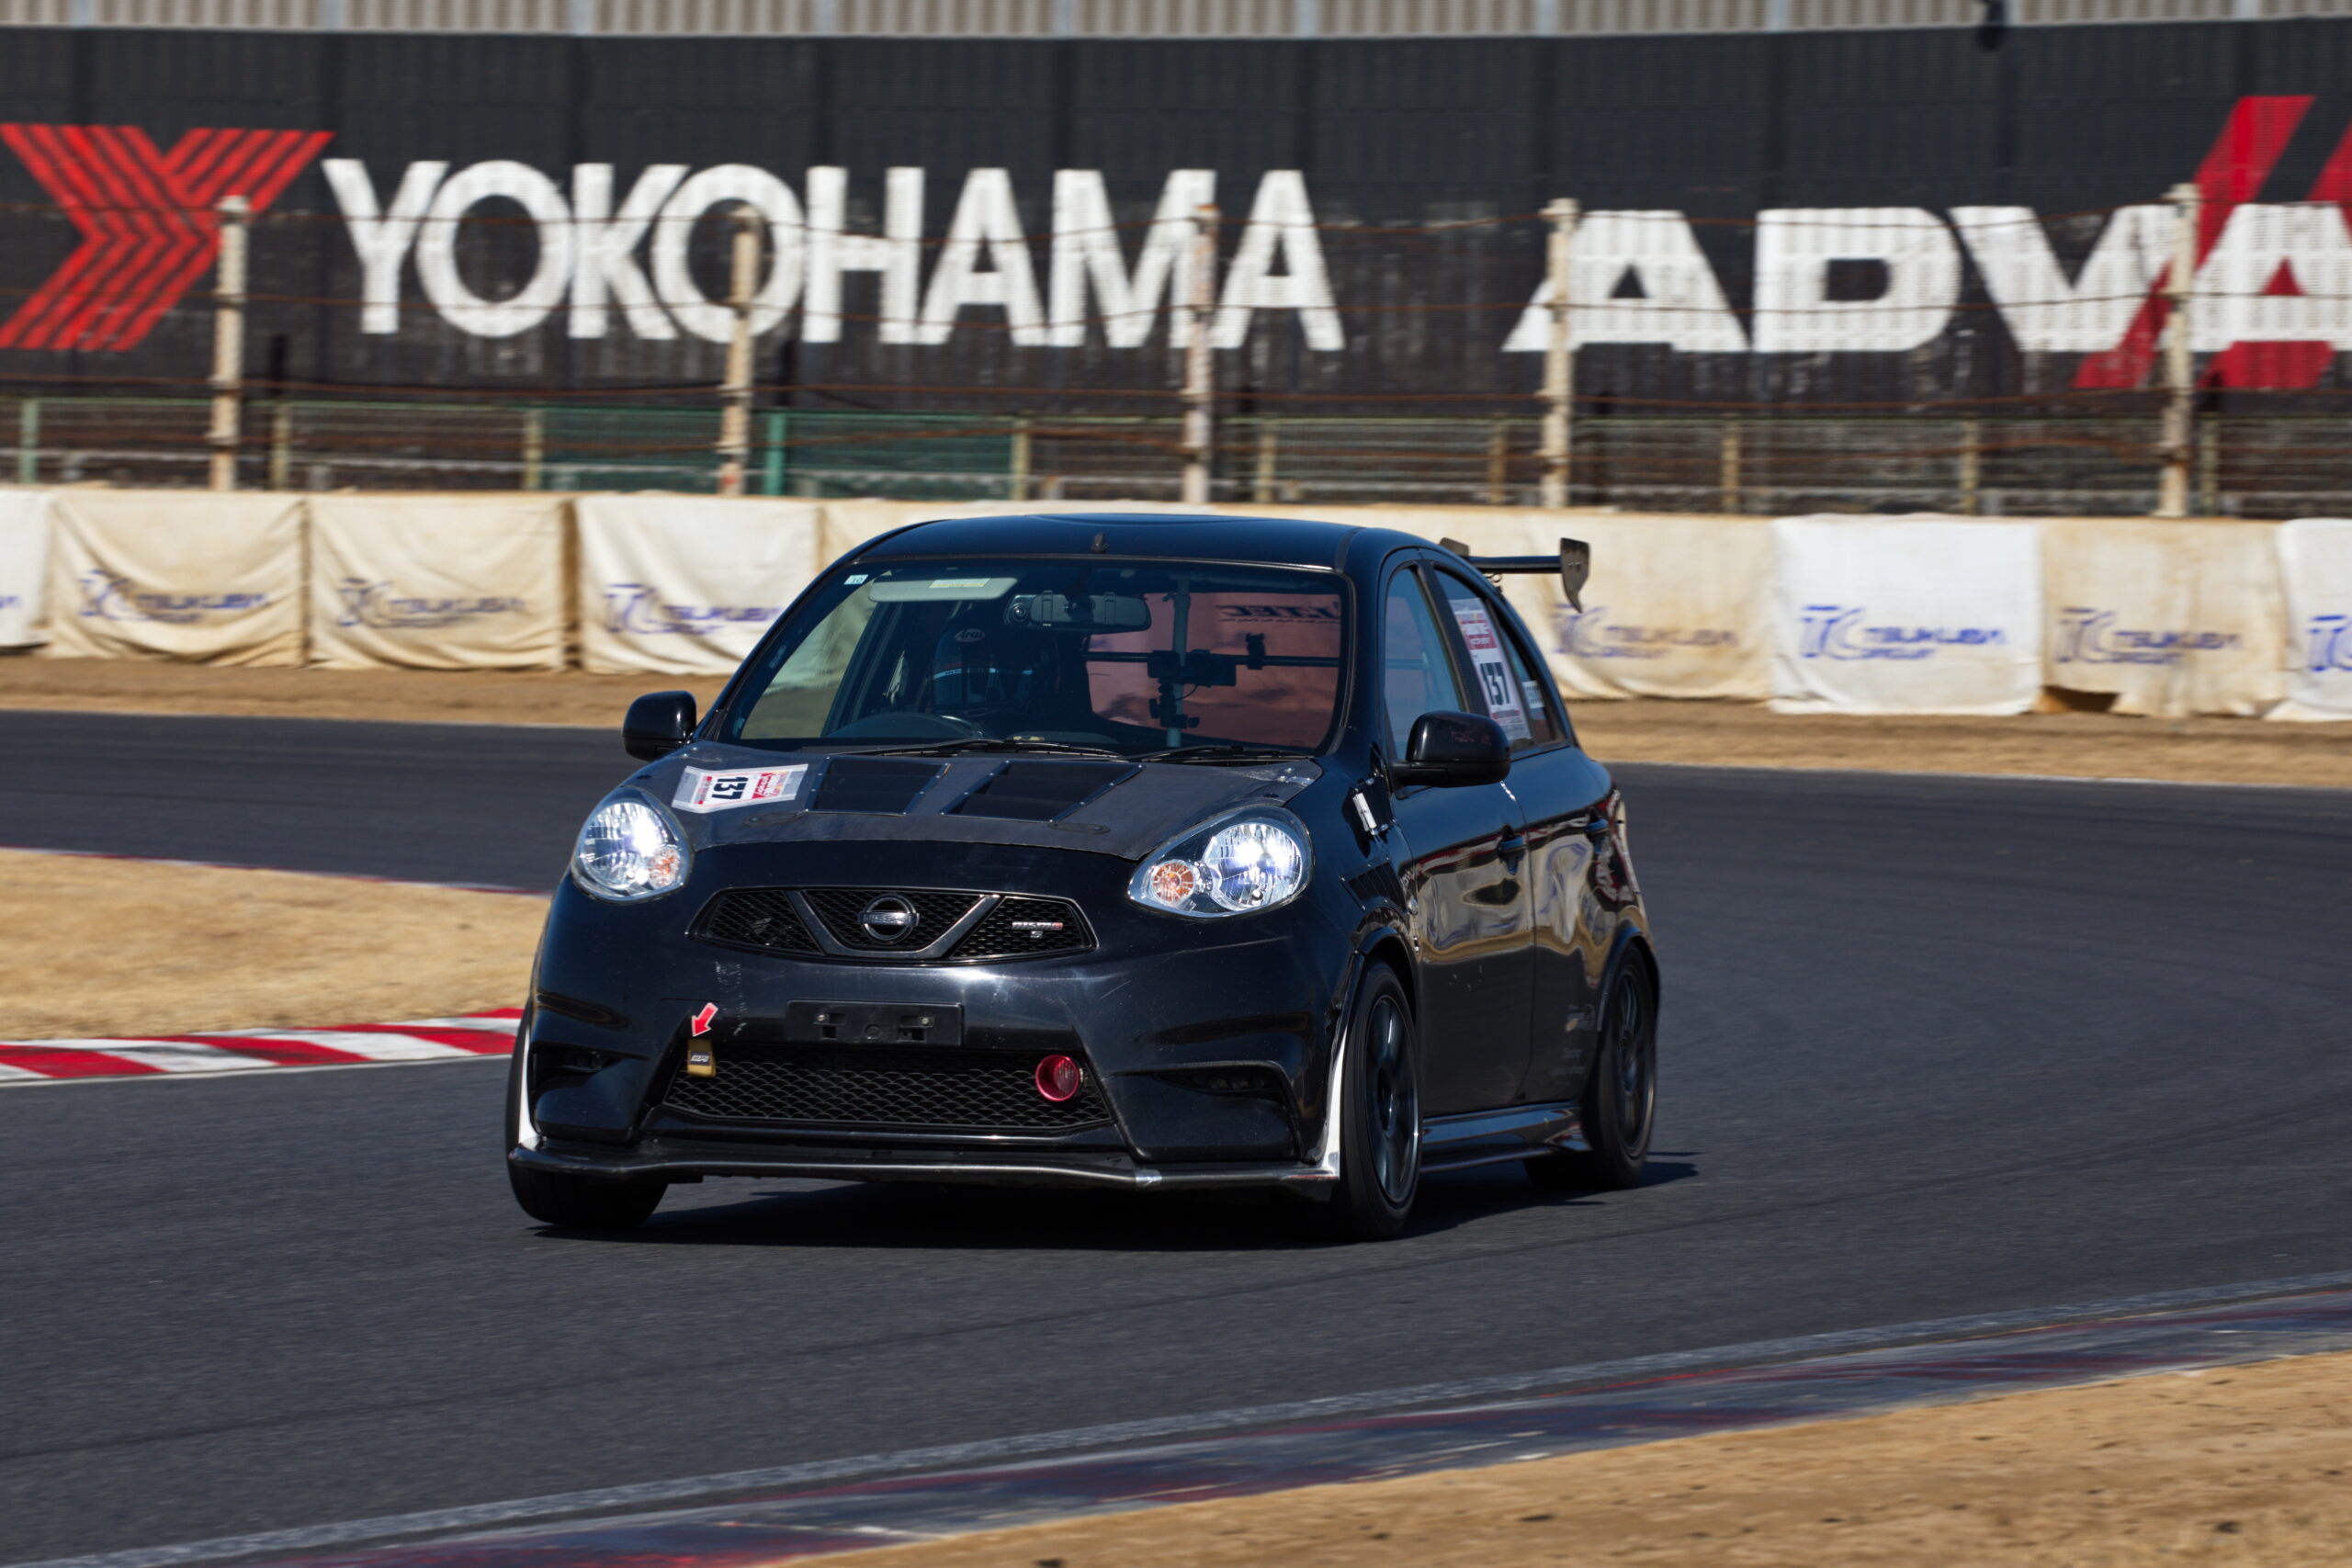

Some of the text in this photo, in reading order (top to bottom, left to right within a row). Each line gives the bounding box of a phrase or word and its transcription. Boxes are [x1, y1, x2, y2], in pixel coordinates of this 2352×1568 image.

[322, 158, 1344, 350] YOKOHAMA
[1501, 201, 2352, 354] ADVA
[1479, 661, 1510, 706] 137
[711, 776, 749, 800] 137
